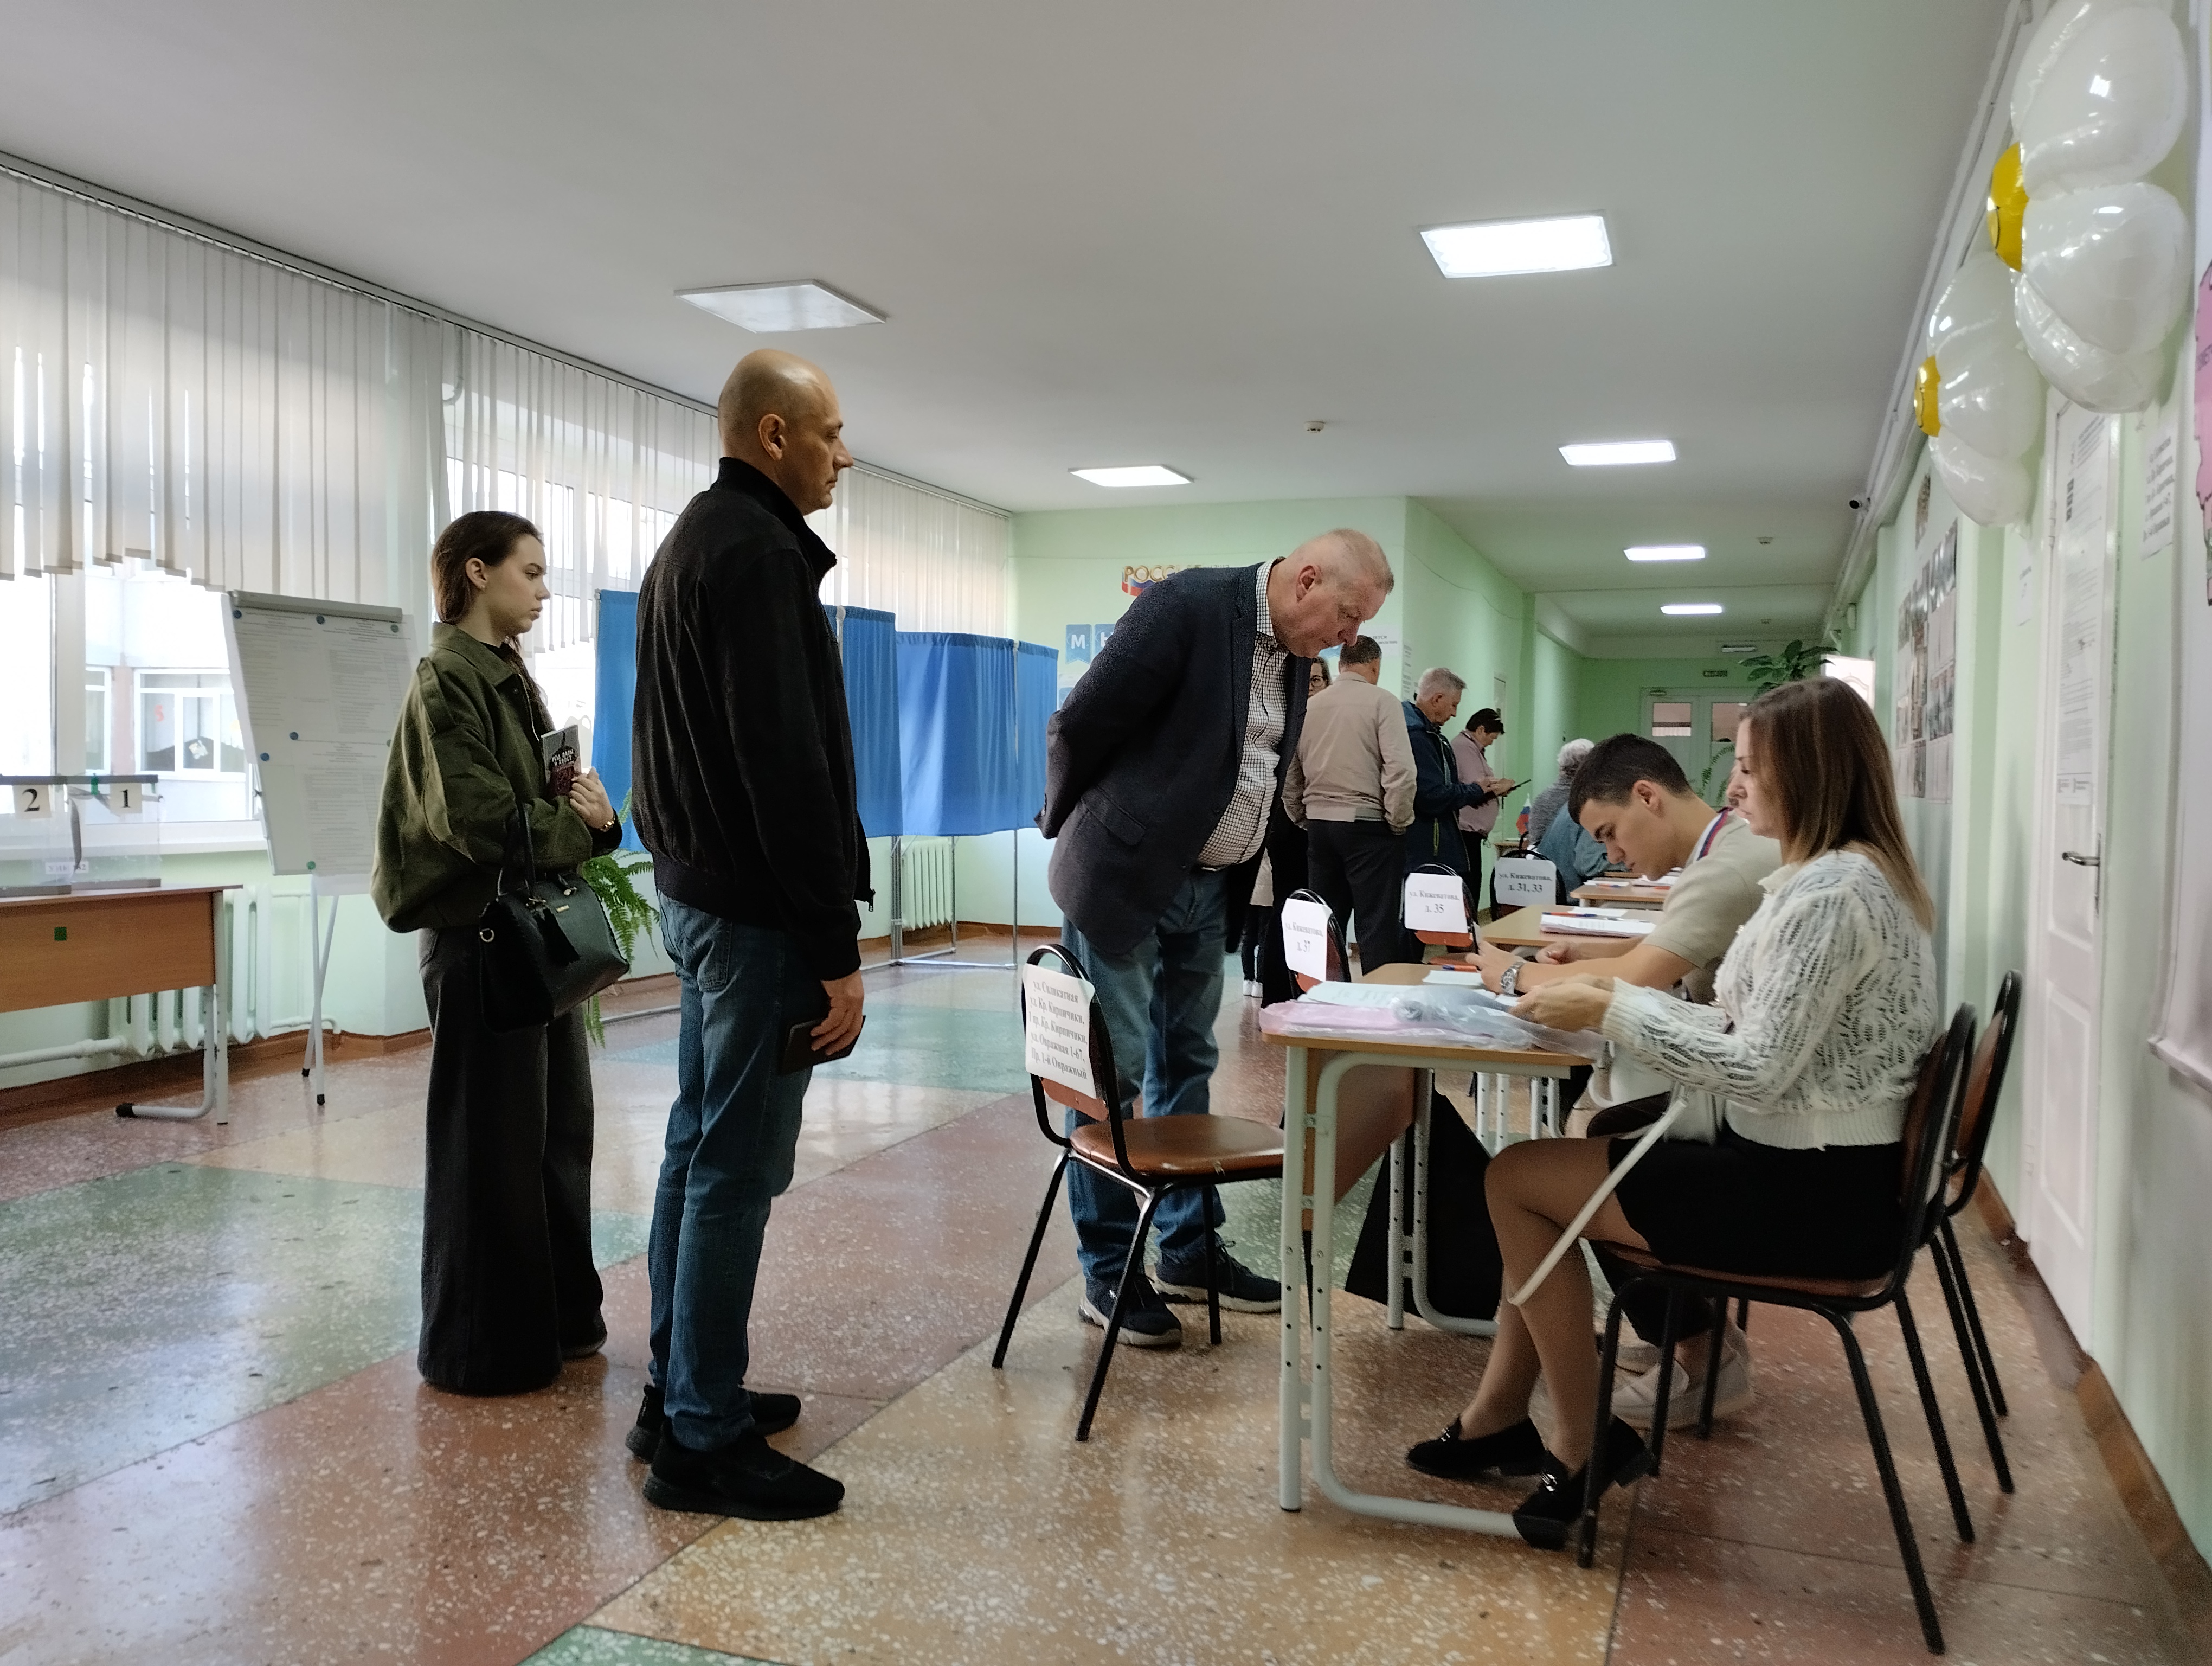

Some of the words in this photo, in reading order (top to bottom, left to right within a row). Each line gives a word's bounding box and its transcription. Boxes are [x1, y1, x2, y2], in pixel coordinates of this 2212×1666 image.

[1124, 565, 1187, 583] РОСС
[22, 788, 40, 812] 2
[120, 789, 131, 808] 1
[1517, 883, 1530, 893] 31,
[1532, 883, 1543, 893] 33
[1433, 903, 1444, 913] 35
[1303, 939, 1311, 953] 37
[1041, 981, 1078, 1003] Силикатная
[1039, 1033, 1069, 1055] Овражная
[1052, 1056, 1088, 1080] Овражный
